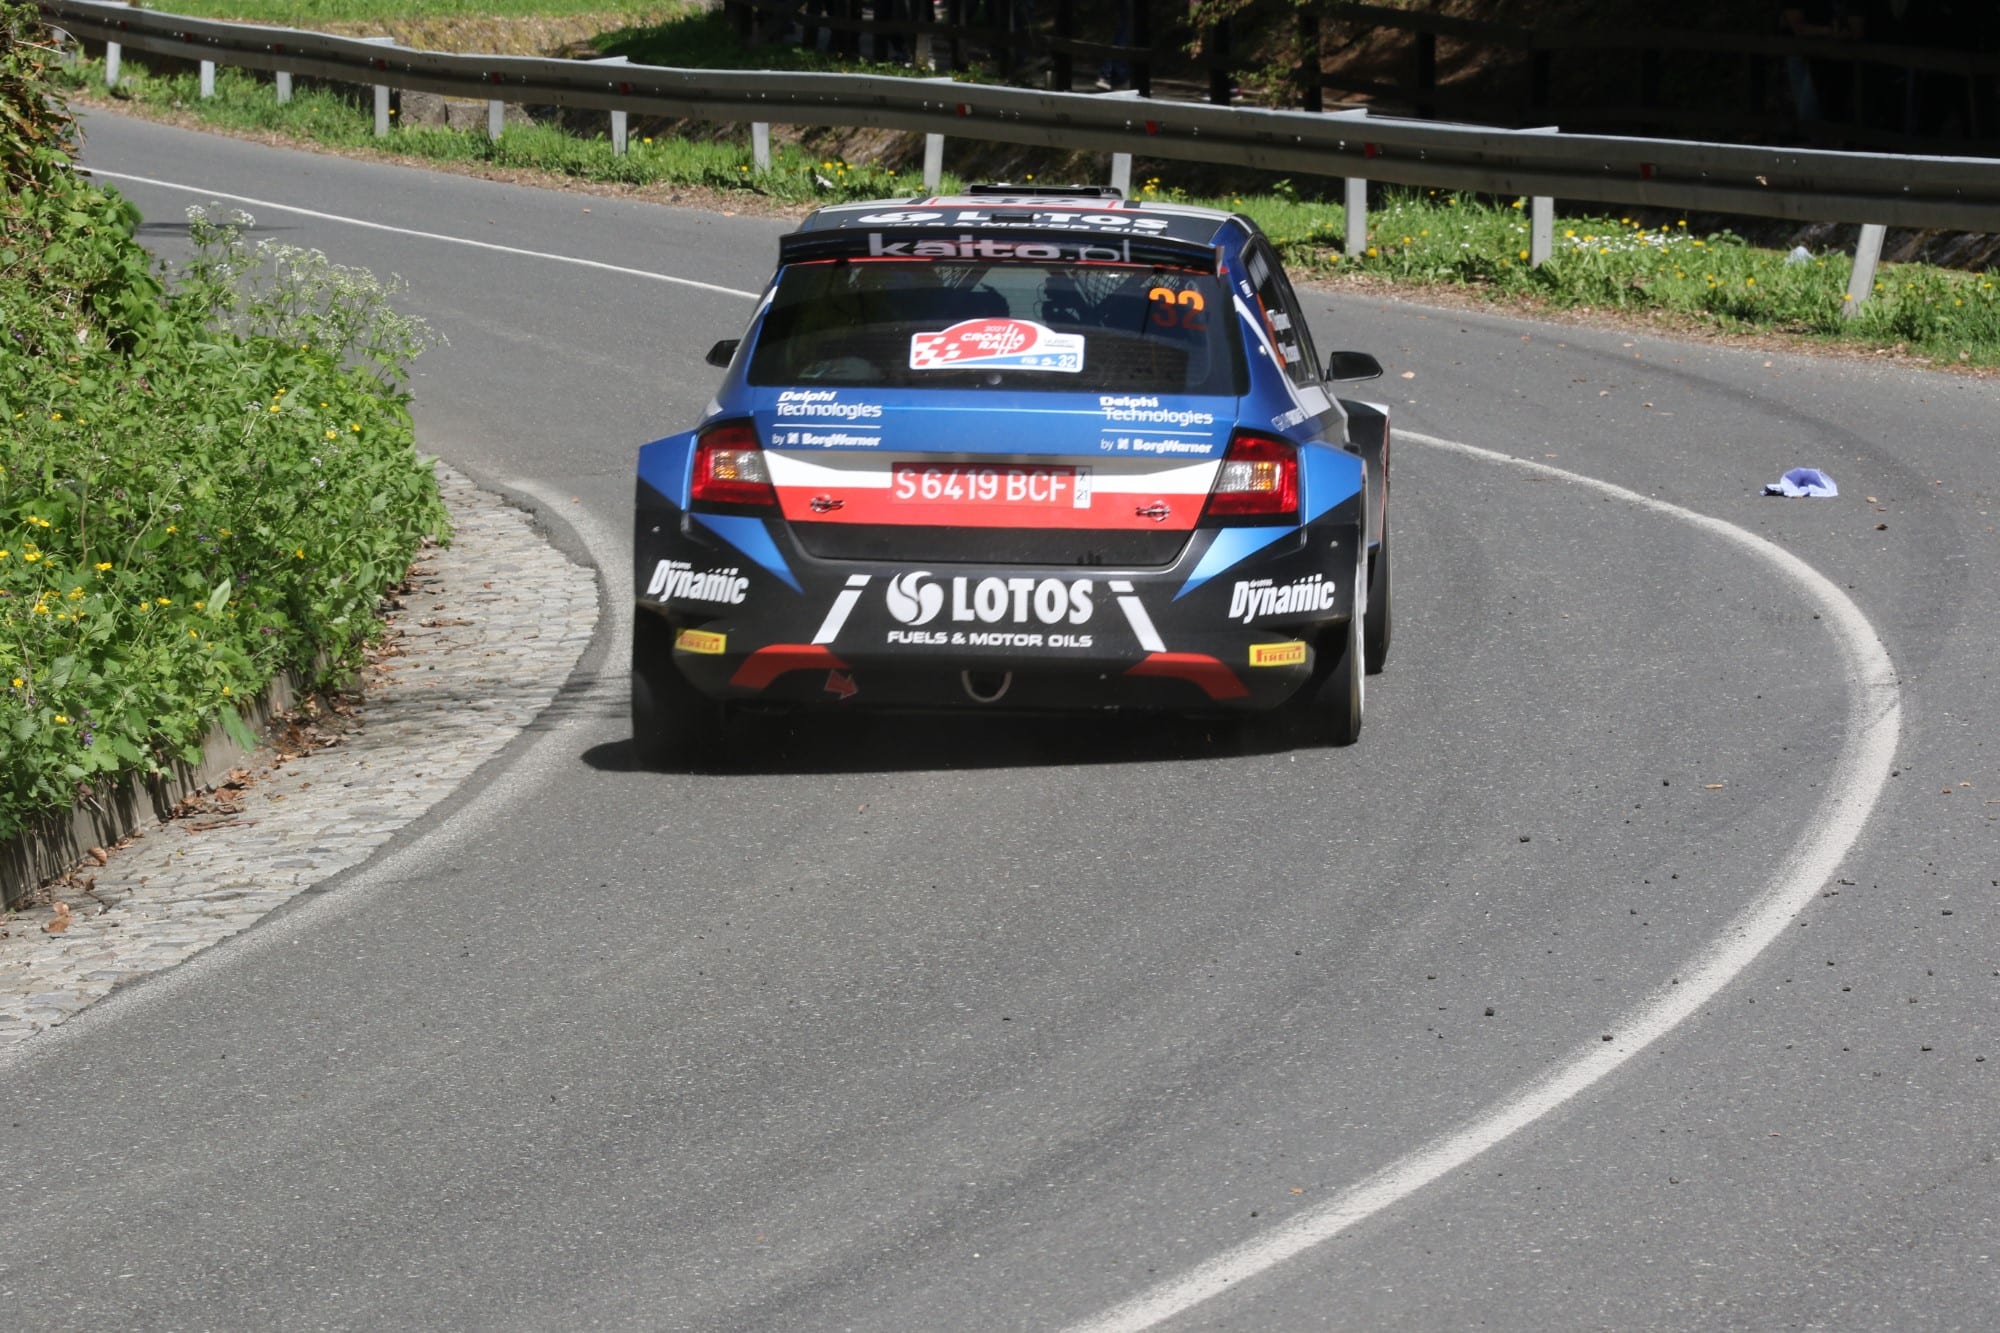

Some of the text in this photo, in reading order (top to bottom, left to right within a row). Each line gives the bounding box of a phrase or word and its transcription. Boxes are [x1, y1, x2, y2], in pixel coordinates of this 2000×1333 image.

[957, 211, 1169, 230] LTOS
[868, 232, 1131, 263] kaito.pl
[1058, 354, 1076, 369] 32
[777, 390, 837, 404] Delphi
[1099, 396, 1159, 409] Delphi
[776, 402, 882, 420] Technologies
[1101, 407, 1214, 427] Technologies
[771, 432, 882, 448] by BorgWarner
[1100, 438, 1214, 454] by BorgWarner
[921, 468, 999, 501] 6419
[1006, 469, 1071, 502] BCF
[647, 559, 750, 605] Dynamic
[952, 576, 1094, 625] LOTOS
[1228, 573, 1336, 624] Dynamic
[887, 630, 1093, 648] FUELS & MOTOR OILS
[1256, 645, 1303, 663] PIRELLI
